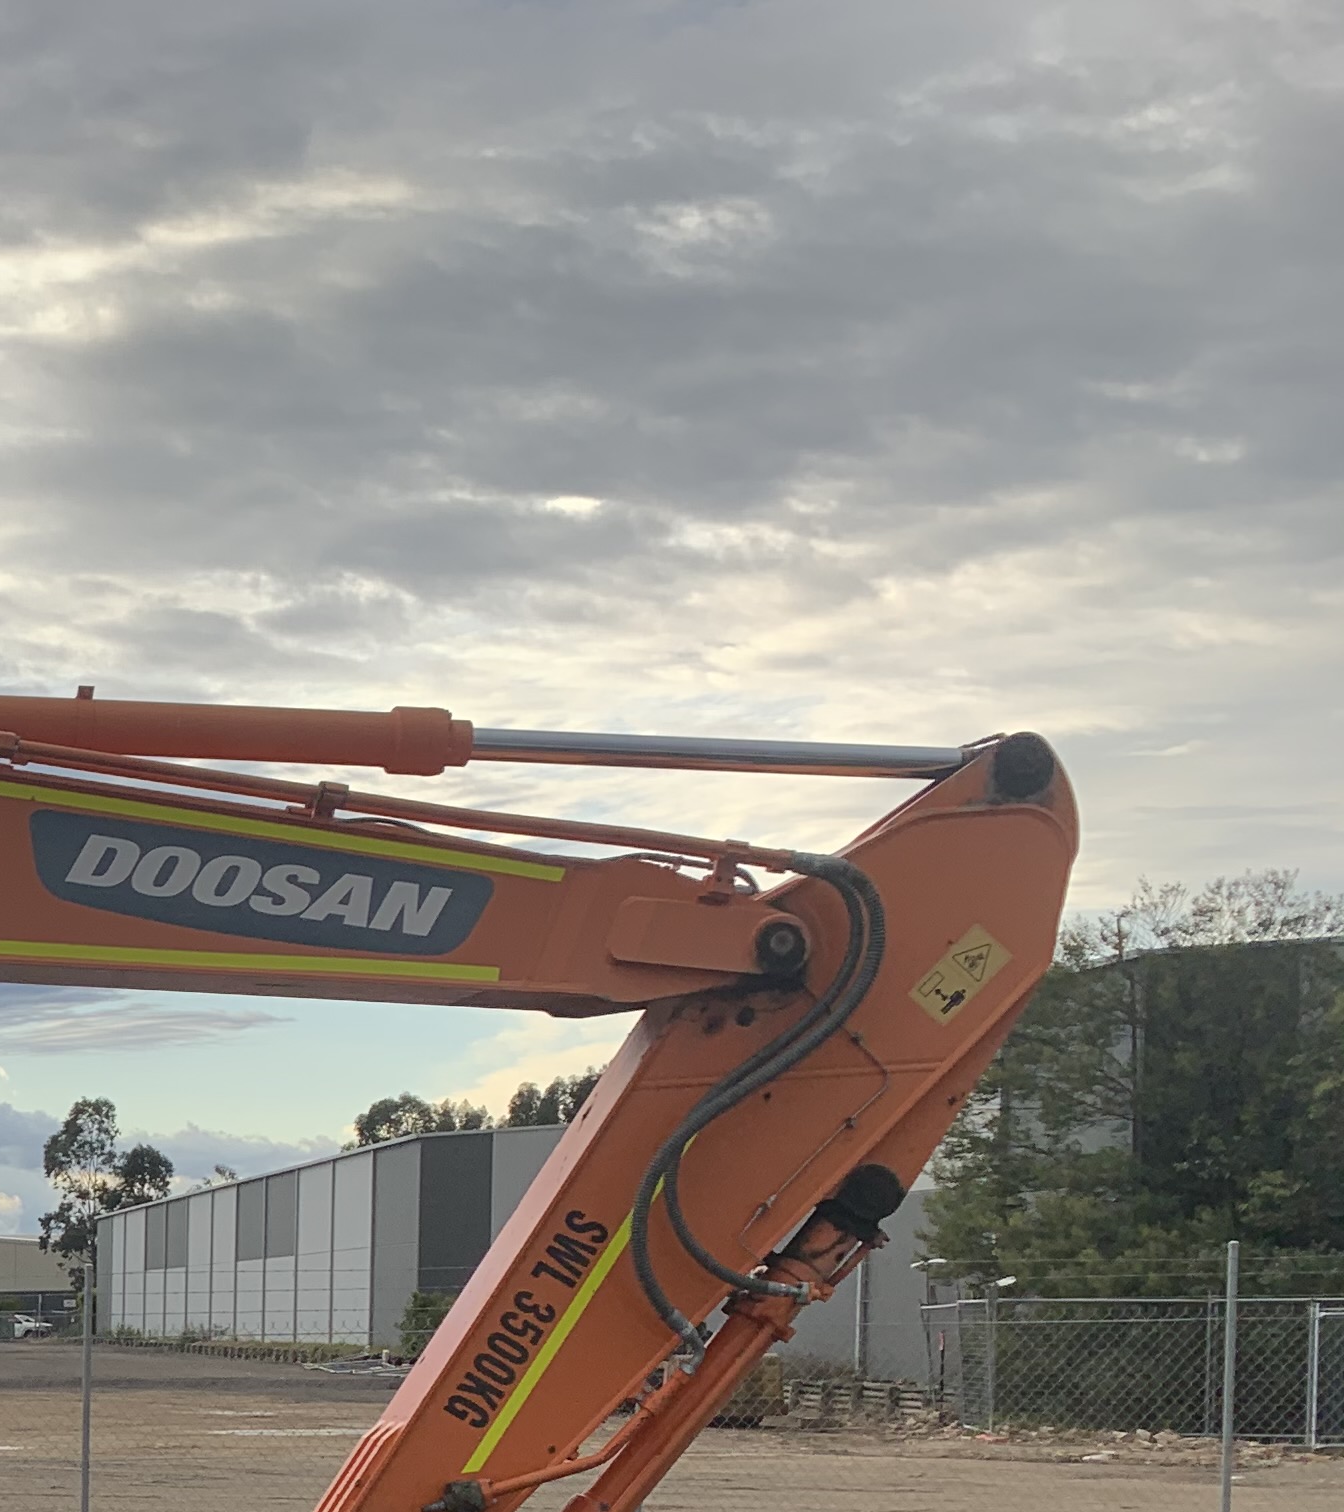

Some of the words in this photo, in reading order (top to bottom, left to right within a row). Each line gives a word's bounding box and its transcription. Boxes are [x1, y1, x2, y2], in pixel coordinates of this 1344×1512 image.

[65, 834, 453, 937] DOOSAN
[530, 1210, 609, 1288] SWL
[443, 1291, 556, 1428] 3500KG
